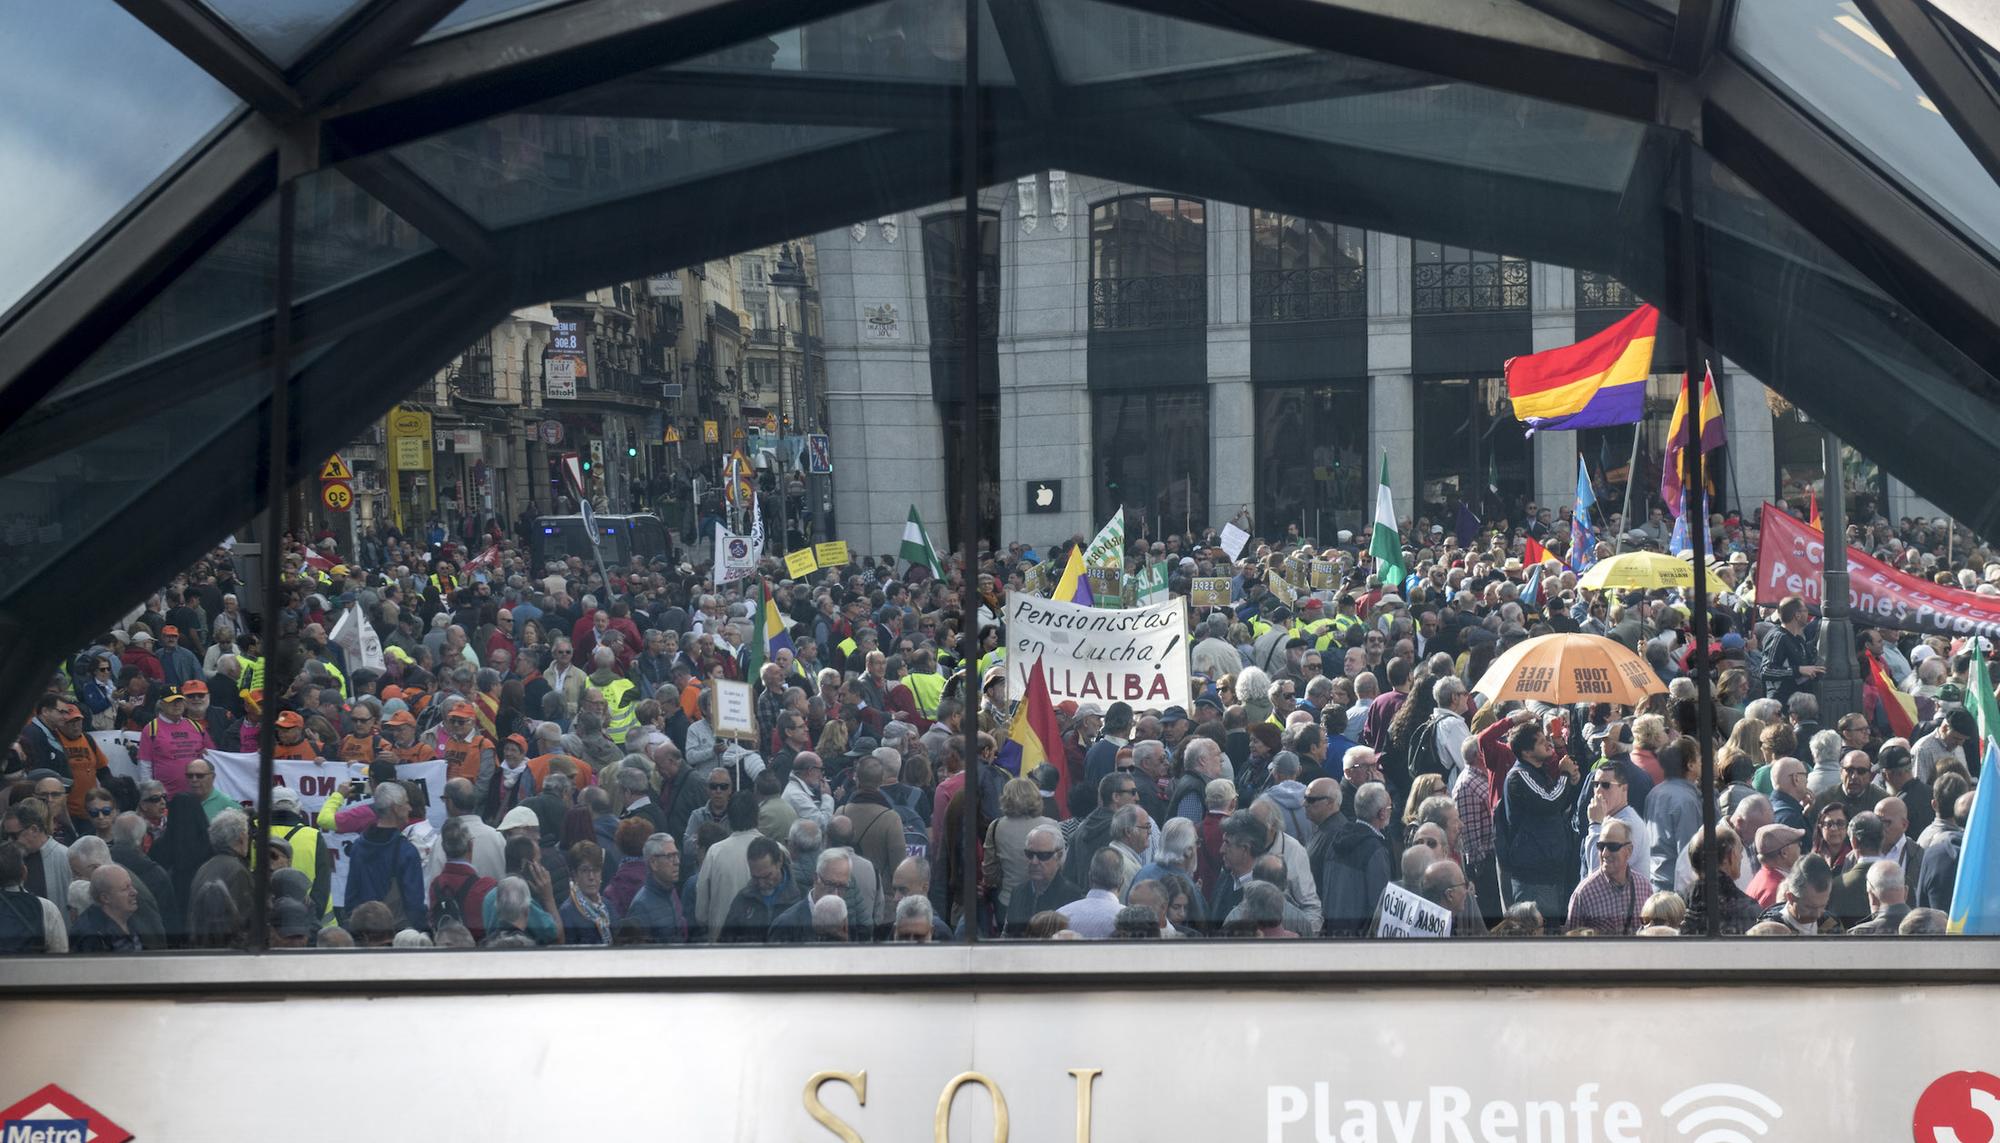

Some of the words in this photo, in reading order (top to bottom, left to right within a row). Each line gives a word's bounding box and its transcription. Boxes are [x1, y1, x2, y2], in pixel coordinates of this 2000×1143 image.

[1771, 561, 1908, 620] Penones
[1014, 601, 1177, 632] Pensionistas
[1018, 637, 1046, 657] en
[7, 1125, 82, 1143] Metro
